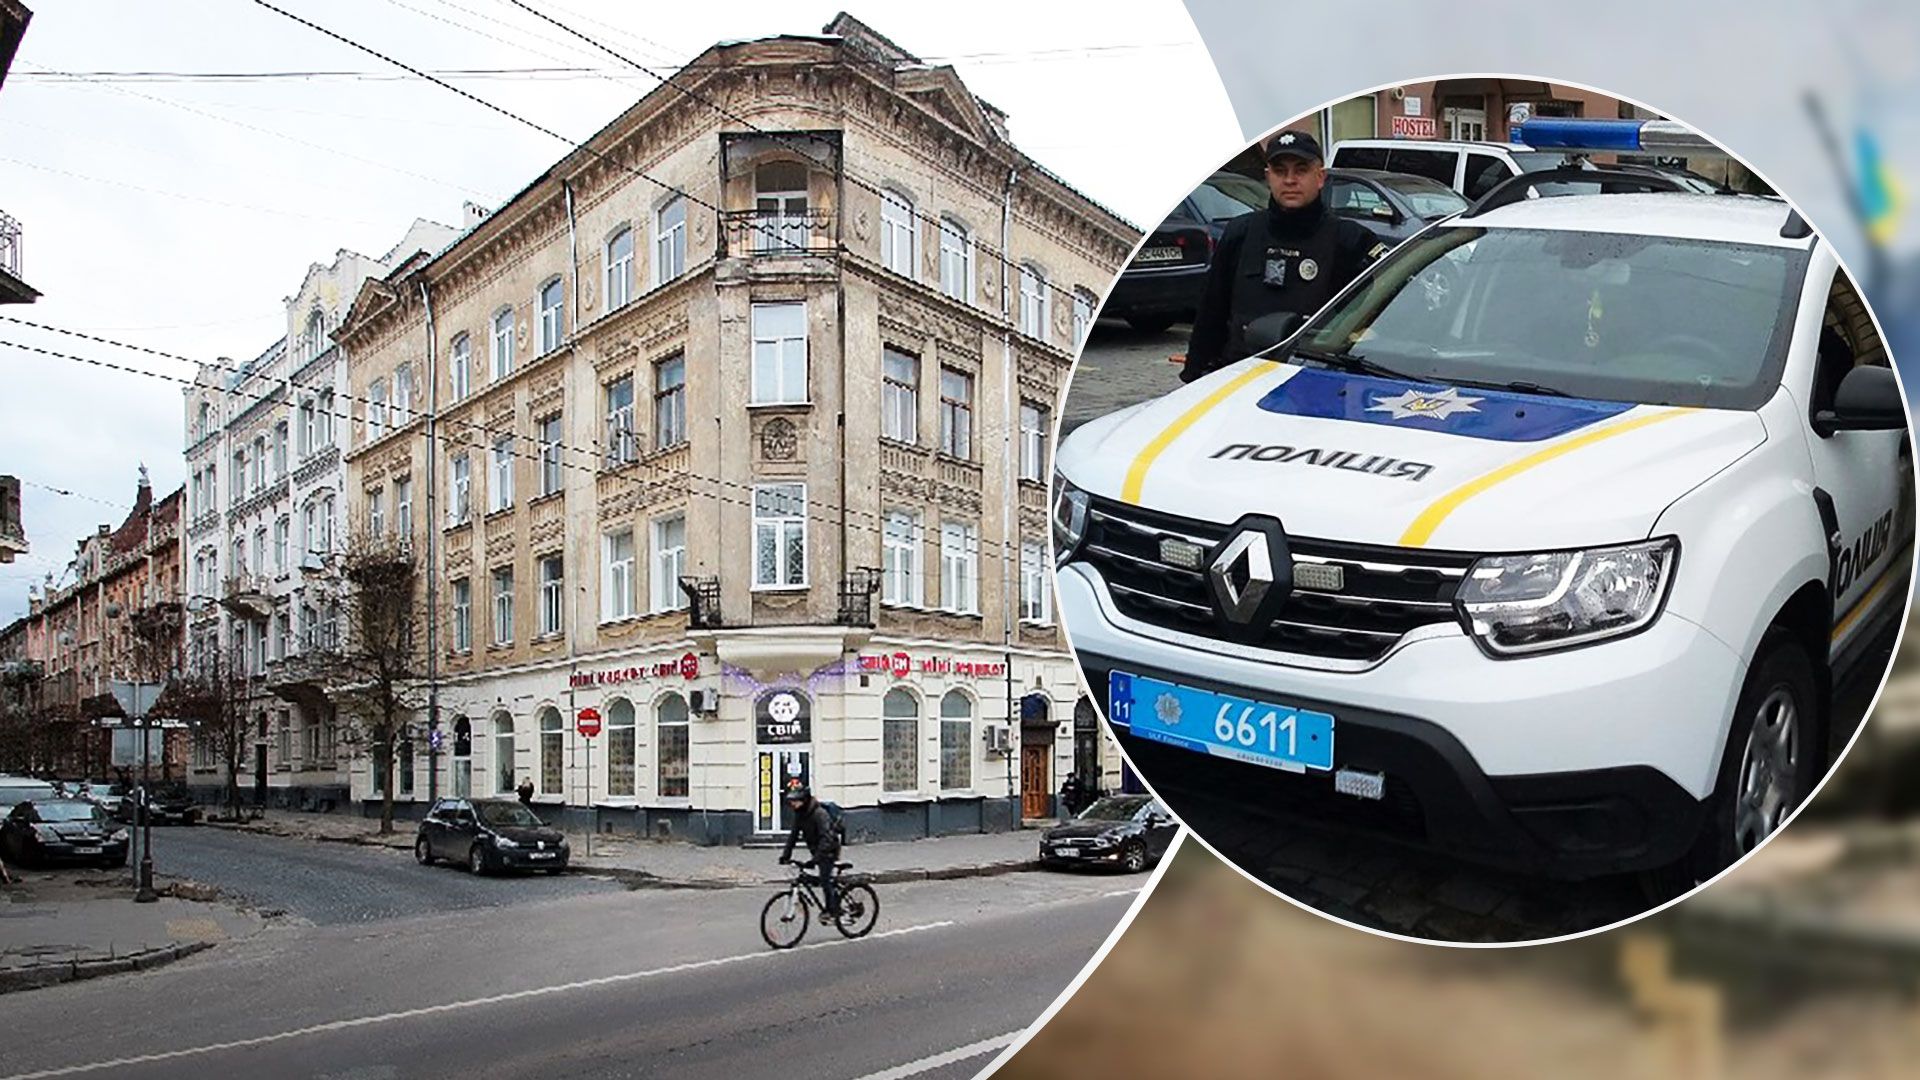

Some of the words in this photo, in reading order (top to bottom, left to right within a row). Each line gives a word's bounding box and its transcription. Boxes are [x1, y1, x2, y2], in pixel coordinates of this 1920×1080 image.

[1393, 118, 1434, 136] HOSTEL
[1209, 444, 1436, 482] ПОЛІЦІЯ
[1835, 508, 1893, 600] ОЛІЦІЯ
[1114, 700, 1130, 719] 11
[1214, 702, 1297, 756] 6611
